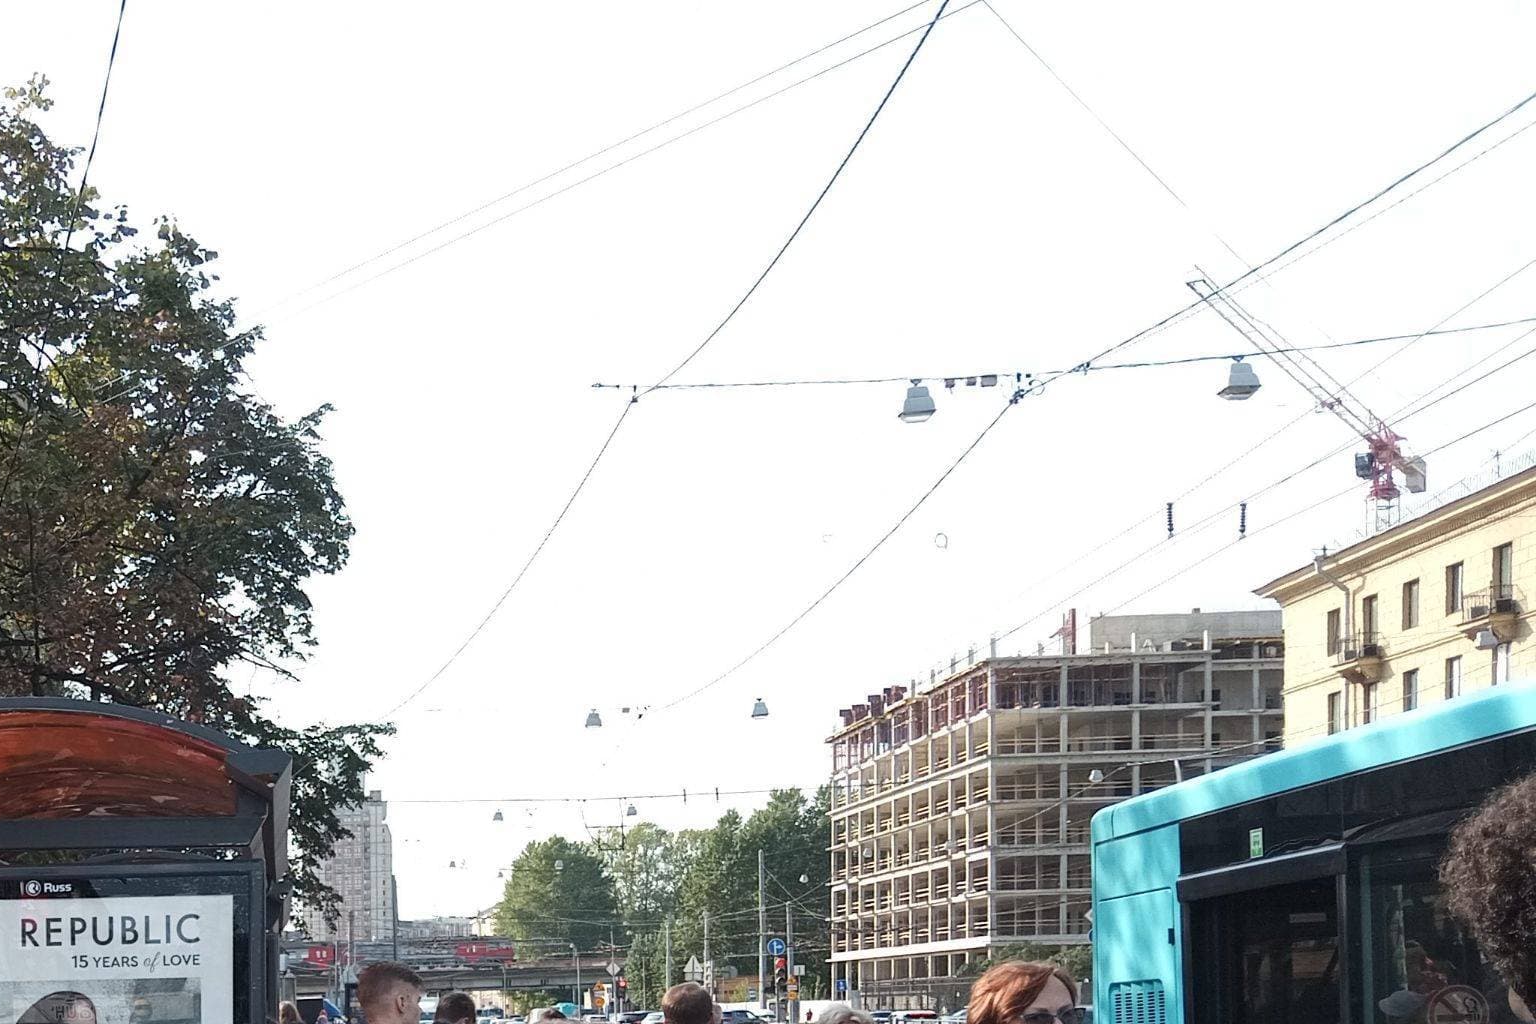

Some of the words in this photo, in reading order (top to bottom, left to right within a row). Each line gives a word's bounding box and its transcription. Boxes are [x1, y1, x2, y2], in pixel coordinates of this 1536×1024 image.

[43, 881, 72, 893] Russ
[20, 913, 201, 948] REPUBLIC
[71, 955, 89, 969] 15
[92, 955, 139, 969] YEARS
[142, 951, 161, 973] of
[163, 953, 201, 967] LOVE
